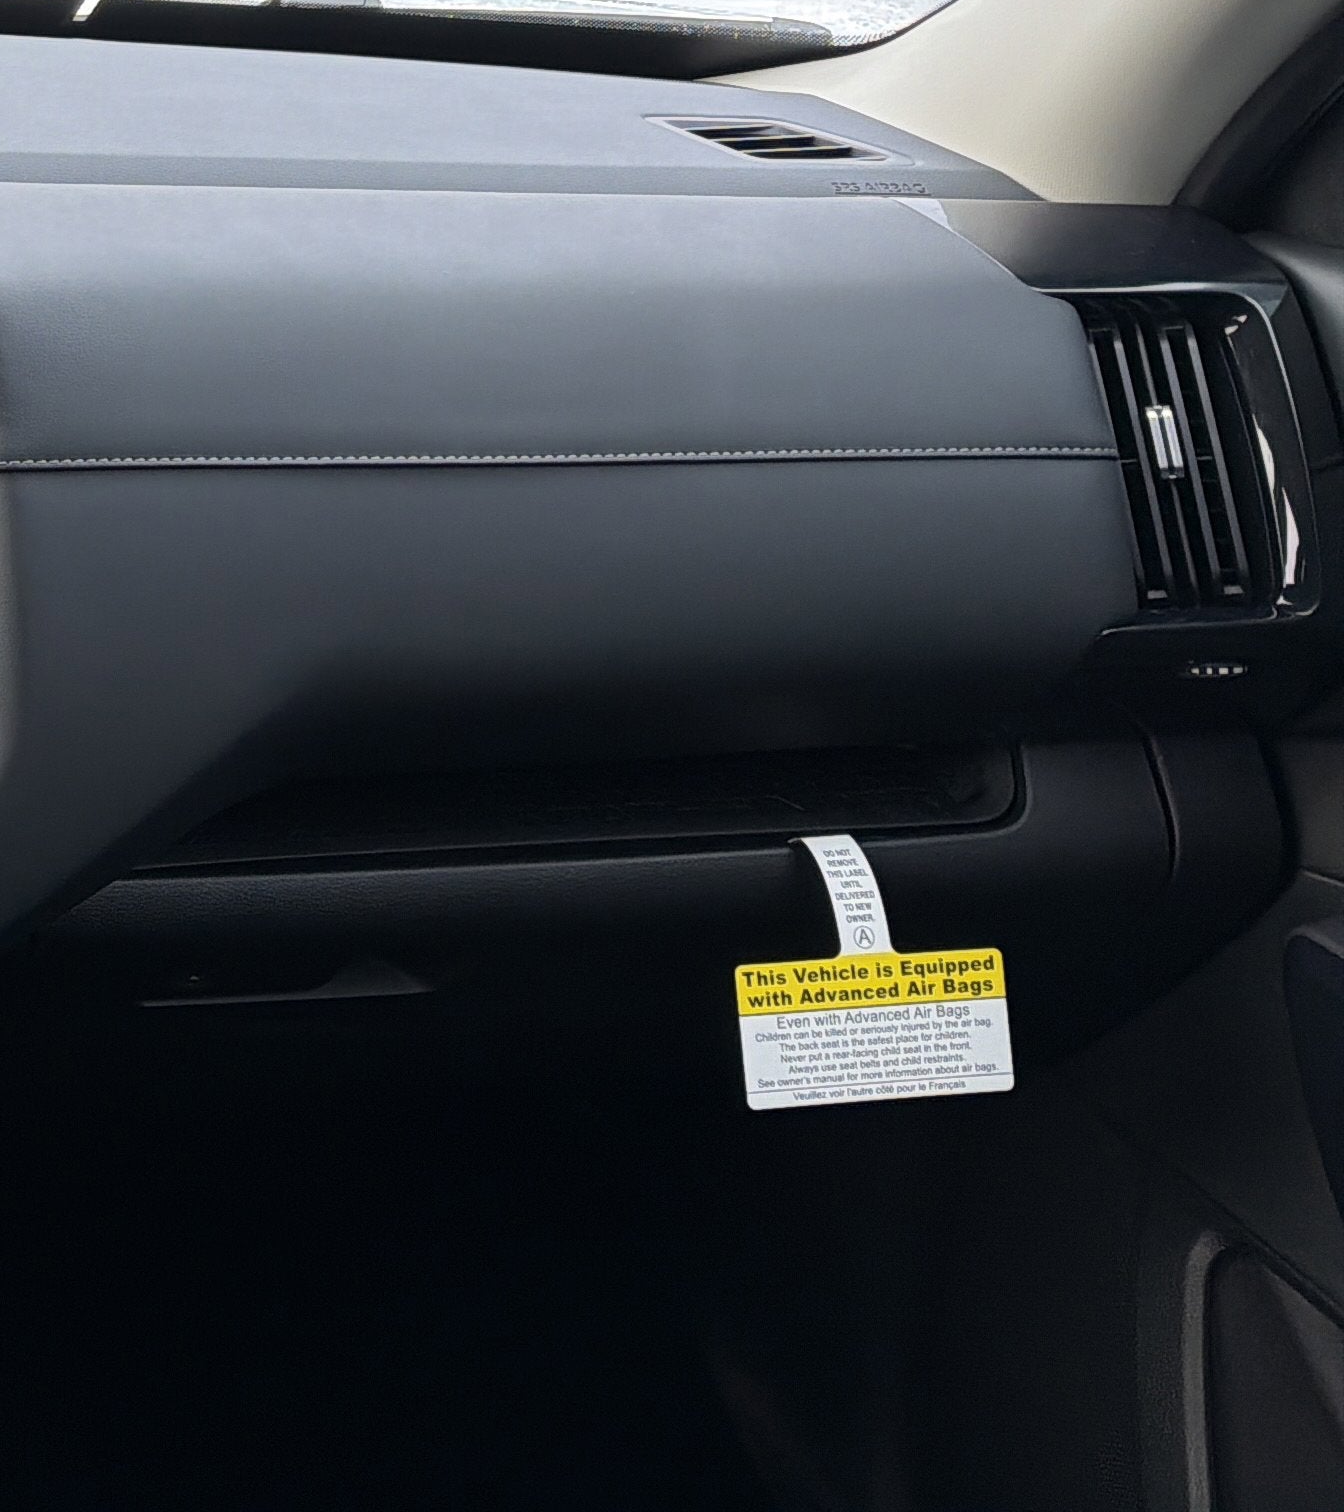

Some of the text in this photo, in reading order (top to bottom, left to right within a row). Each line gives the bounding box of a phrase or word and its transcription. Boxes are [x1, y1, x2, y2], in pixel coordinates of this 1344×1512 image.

[741, 955, 995, 987] This Vehicle is Equipped
[747, 978, 994, 1008] with Advanced Air Bags
[776, 1004, 971, 1030] Even with Advanced Air Bags
[754, 1032, 792, 1043] Children
[793, 1031, 810, 1040] can
[810, 1029, 823, 1039] be
[824, 1027, 848, 1038] killed
[849, 1027, 858, 1036] or
[860, 1024, 899, 1035] seriously
[900, 1021, 931, 1033] injured
[931, 1020, 943, 1031] by
[944, 1019, 959, 1029] the
[960, 1018, 972, 1028] air
[779, 1043, 797, 1053] The
[797, 1040, 820, 1051] back
[820, 1039, 841, 1050] seat
[841, 1038, 850, 1048] is
[850, 1037, 866, 1047] the
[867, 1035, 894, 1046] safest
[895, 1034, 919, 1045] place
[920, 1032, 933, 1042] for
[779, 1054, 807, 1064] Never
[808, 1052, 824, 1063] put
[824, 1052, 831, 1061] a
[832, 1048, 879, 1060] rear-facing
[880, 1046, 901, 1057] child
[902, 1044, 923, 1055] seat
[923, 1044, 932, 1053] in
[933, 1042, 948, 1053] the
[788, 1064, 820, 1075] Always
[820, 1063, 838, 1072] use
[838, 1060, 859, 1071] seat
[859, 1059, 881, 1069] belts
[882, 1057, 900, 1068] and
[900, 1055, 922, 1066] child
[757, 1079, 776, 1089] See
[812, 1073, 845, 1084] manual
[846, 1072, 859, 1082] for
[860, 1071, 884, 1080] more
[884, 1067, 933, 1078] information
[934, 1064, 960, 1075] about
[961, 1063, 973, 1073] air
